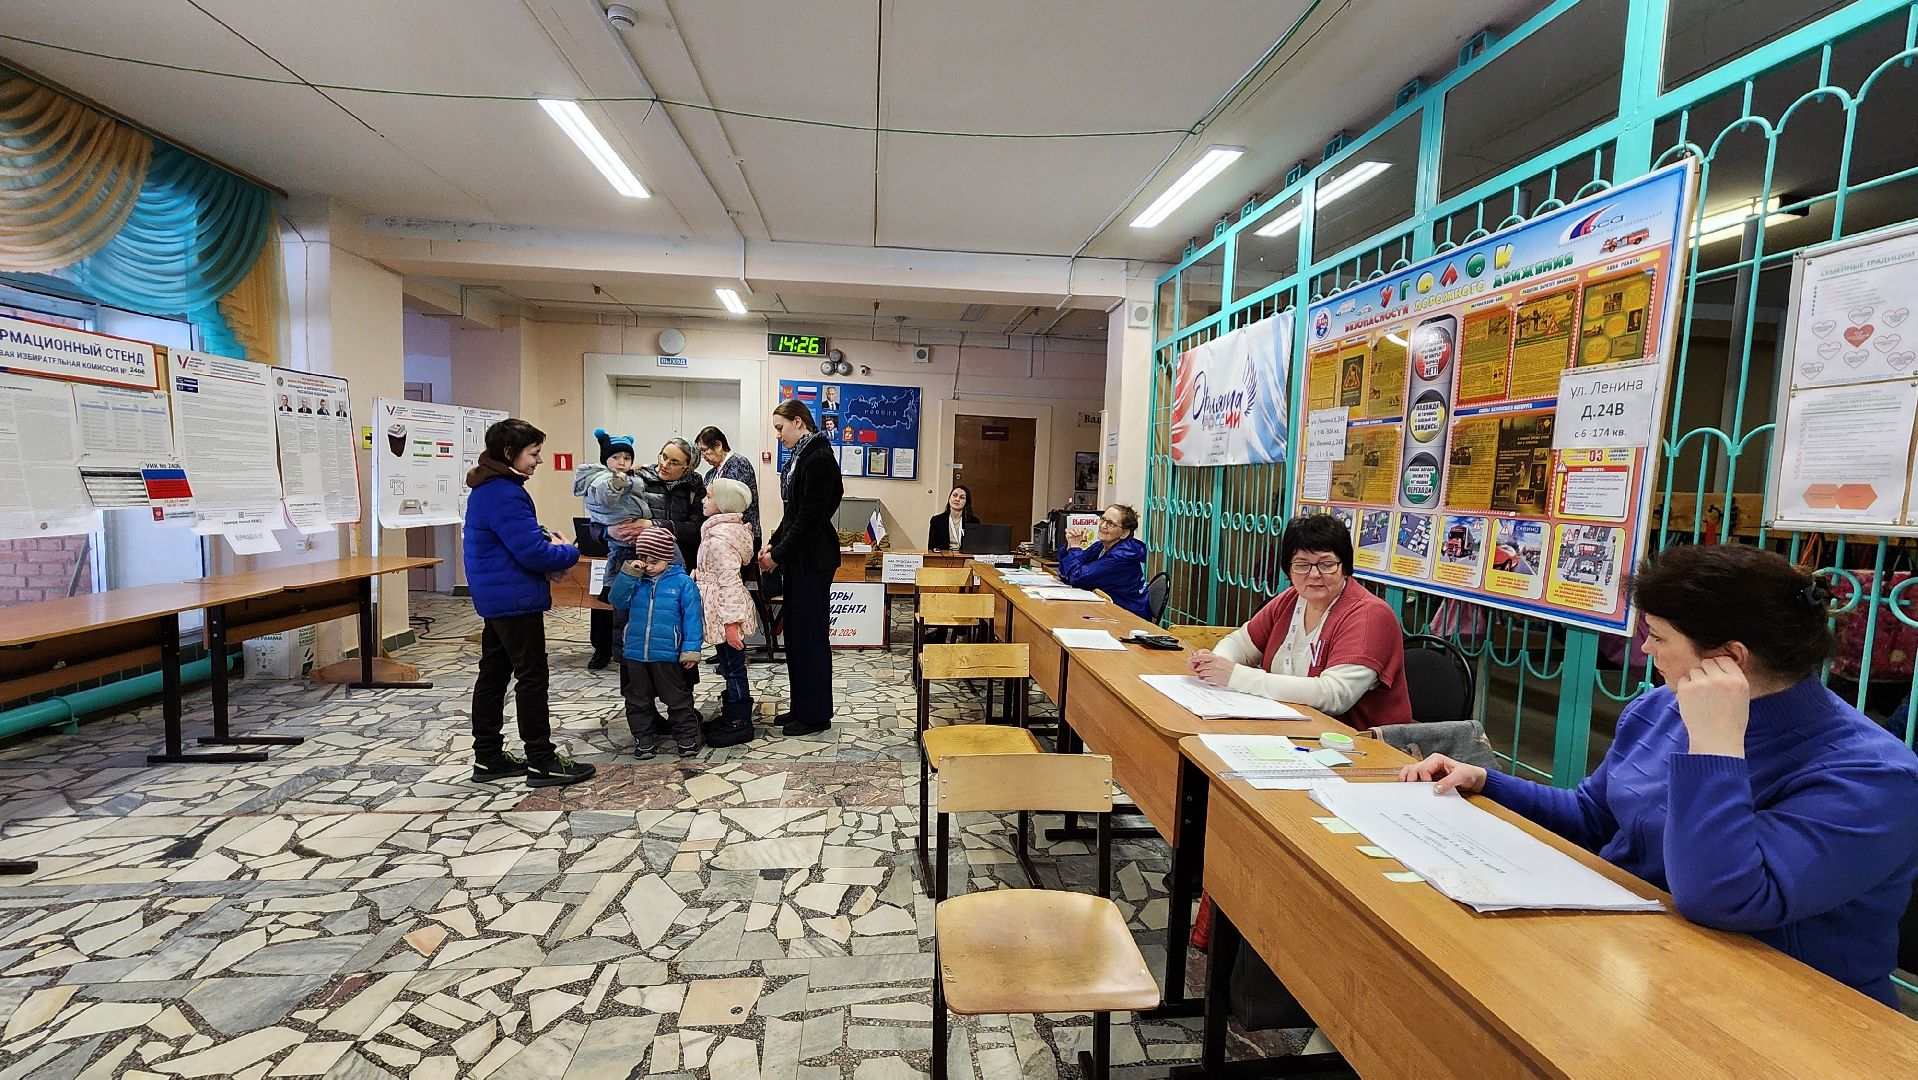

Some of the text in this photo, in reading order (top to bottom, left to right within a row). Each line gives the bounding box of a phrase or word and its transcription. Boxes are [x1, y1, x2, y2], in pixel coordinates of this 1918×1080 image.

[1821, 251, 1915, 277] СЕМЕЙНЫЕ ТРАДИЦИИ
[1380, 243, 1515, 308] УГОЛОК
[1414, 279, 1485, 312] ДОРОЖНОГО
[1492, 252, 1574, 288] ДВИЖЕНИЯ
[778, 335, 819, 354] 14:26
[16, 350, 81, 368] ИЗБИРАТЕЛЬНАЯ
[82, 361, 119, 374] КОМИССИЯ
[129, 366, 145, 375] 2406
[105, 347, 145, 366] СТЕНД
[660, 357, 686, 365] ВЫХОД
[1571, 379, 1643, 399] ул. Ленина
[864, 409, 897, 417] РОССИЯ
[1202, 410, 1241, 431] РОССИИ
[1580, 402, 1625, 421] Д.24В
[1581, 429, 1587, 437] 6
[1612, 429, 1627, 437] кв.
[1589, 449, 1604, 462] 03
[838, 628, 857, 637] 2024
